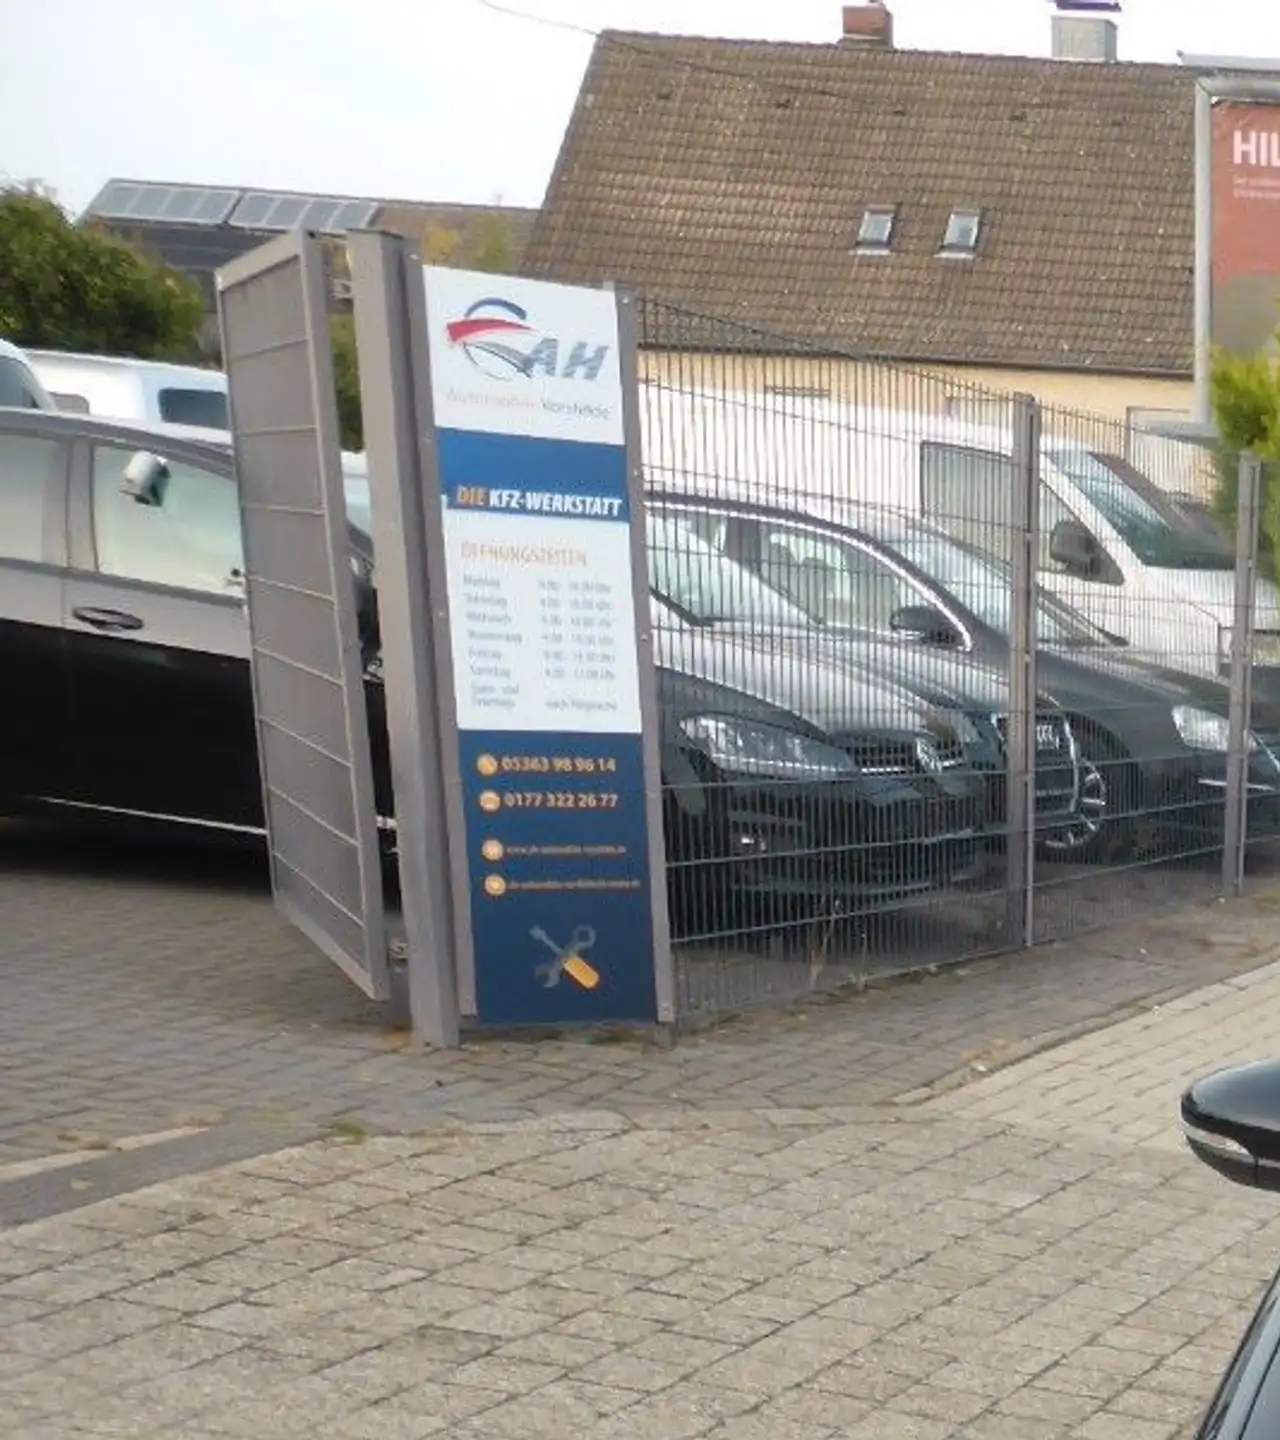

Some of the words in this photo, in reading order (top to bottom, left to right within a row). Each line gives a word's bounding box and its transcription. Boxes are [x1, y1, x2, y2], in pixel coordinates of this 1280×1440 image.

[522, 338, 609, 381] AH
[457, 485, 488, 506] DIE
[489, 488, 623, 517] KFZ-WERKSTATT
[504, 792, 542, 808] 0177
